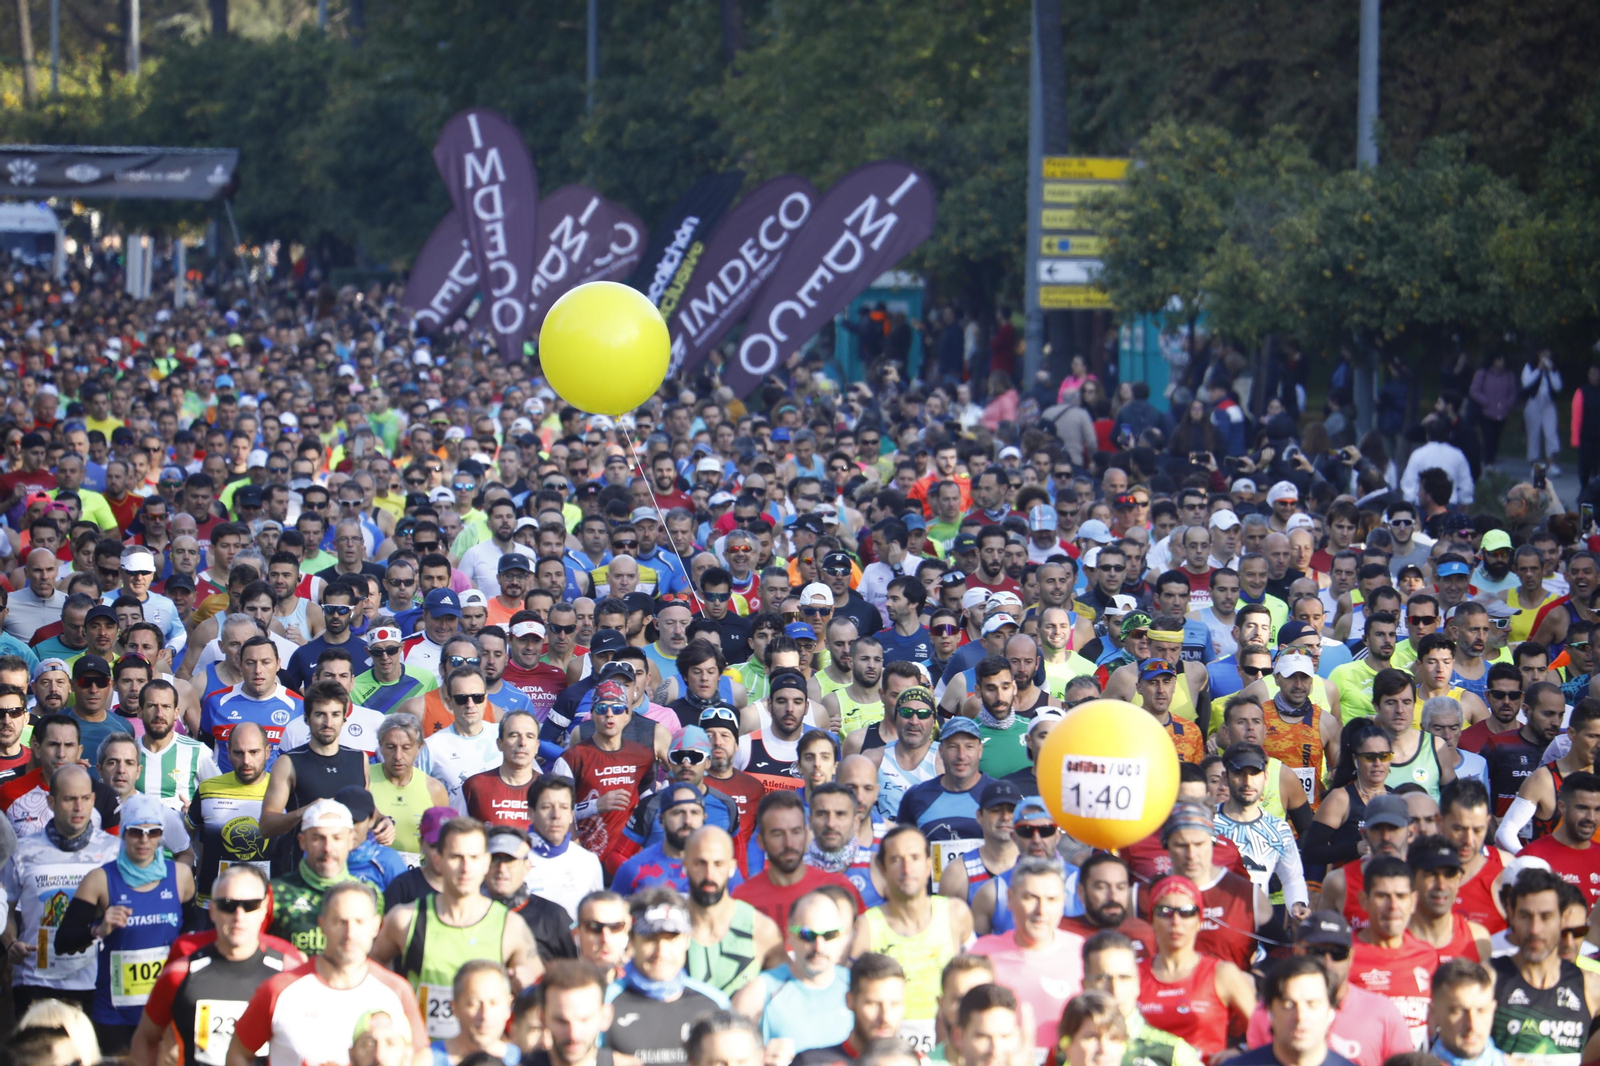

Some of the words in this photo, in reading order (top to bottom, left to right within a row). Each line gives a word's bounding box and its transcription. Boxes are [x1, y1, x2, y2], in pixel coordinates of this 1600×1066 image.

[679, 191, 811, 338] IMDECO
[738, 171, 919, 377] IMDECO
[594, 765, 637, 776] LOBOS
[599, 776, 636, 786] TRAIL
[1070, 783, 1132, 810] 1:40
[1554, 1037, 1582, 1048] TRAIL
